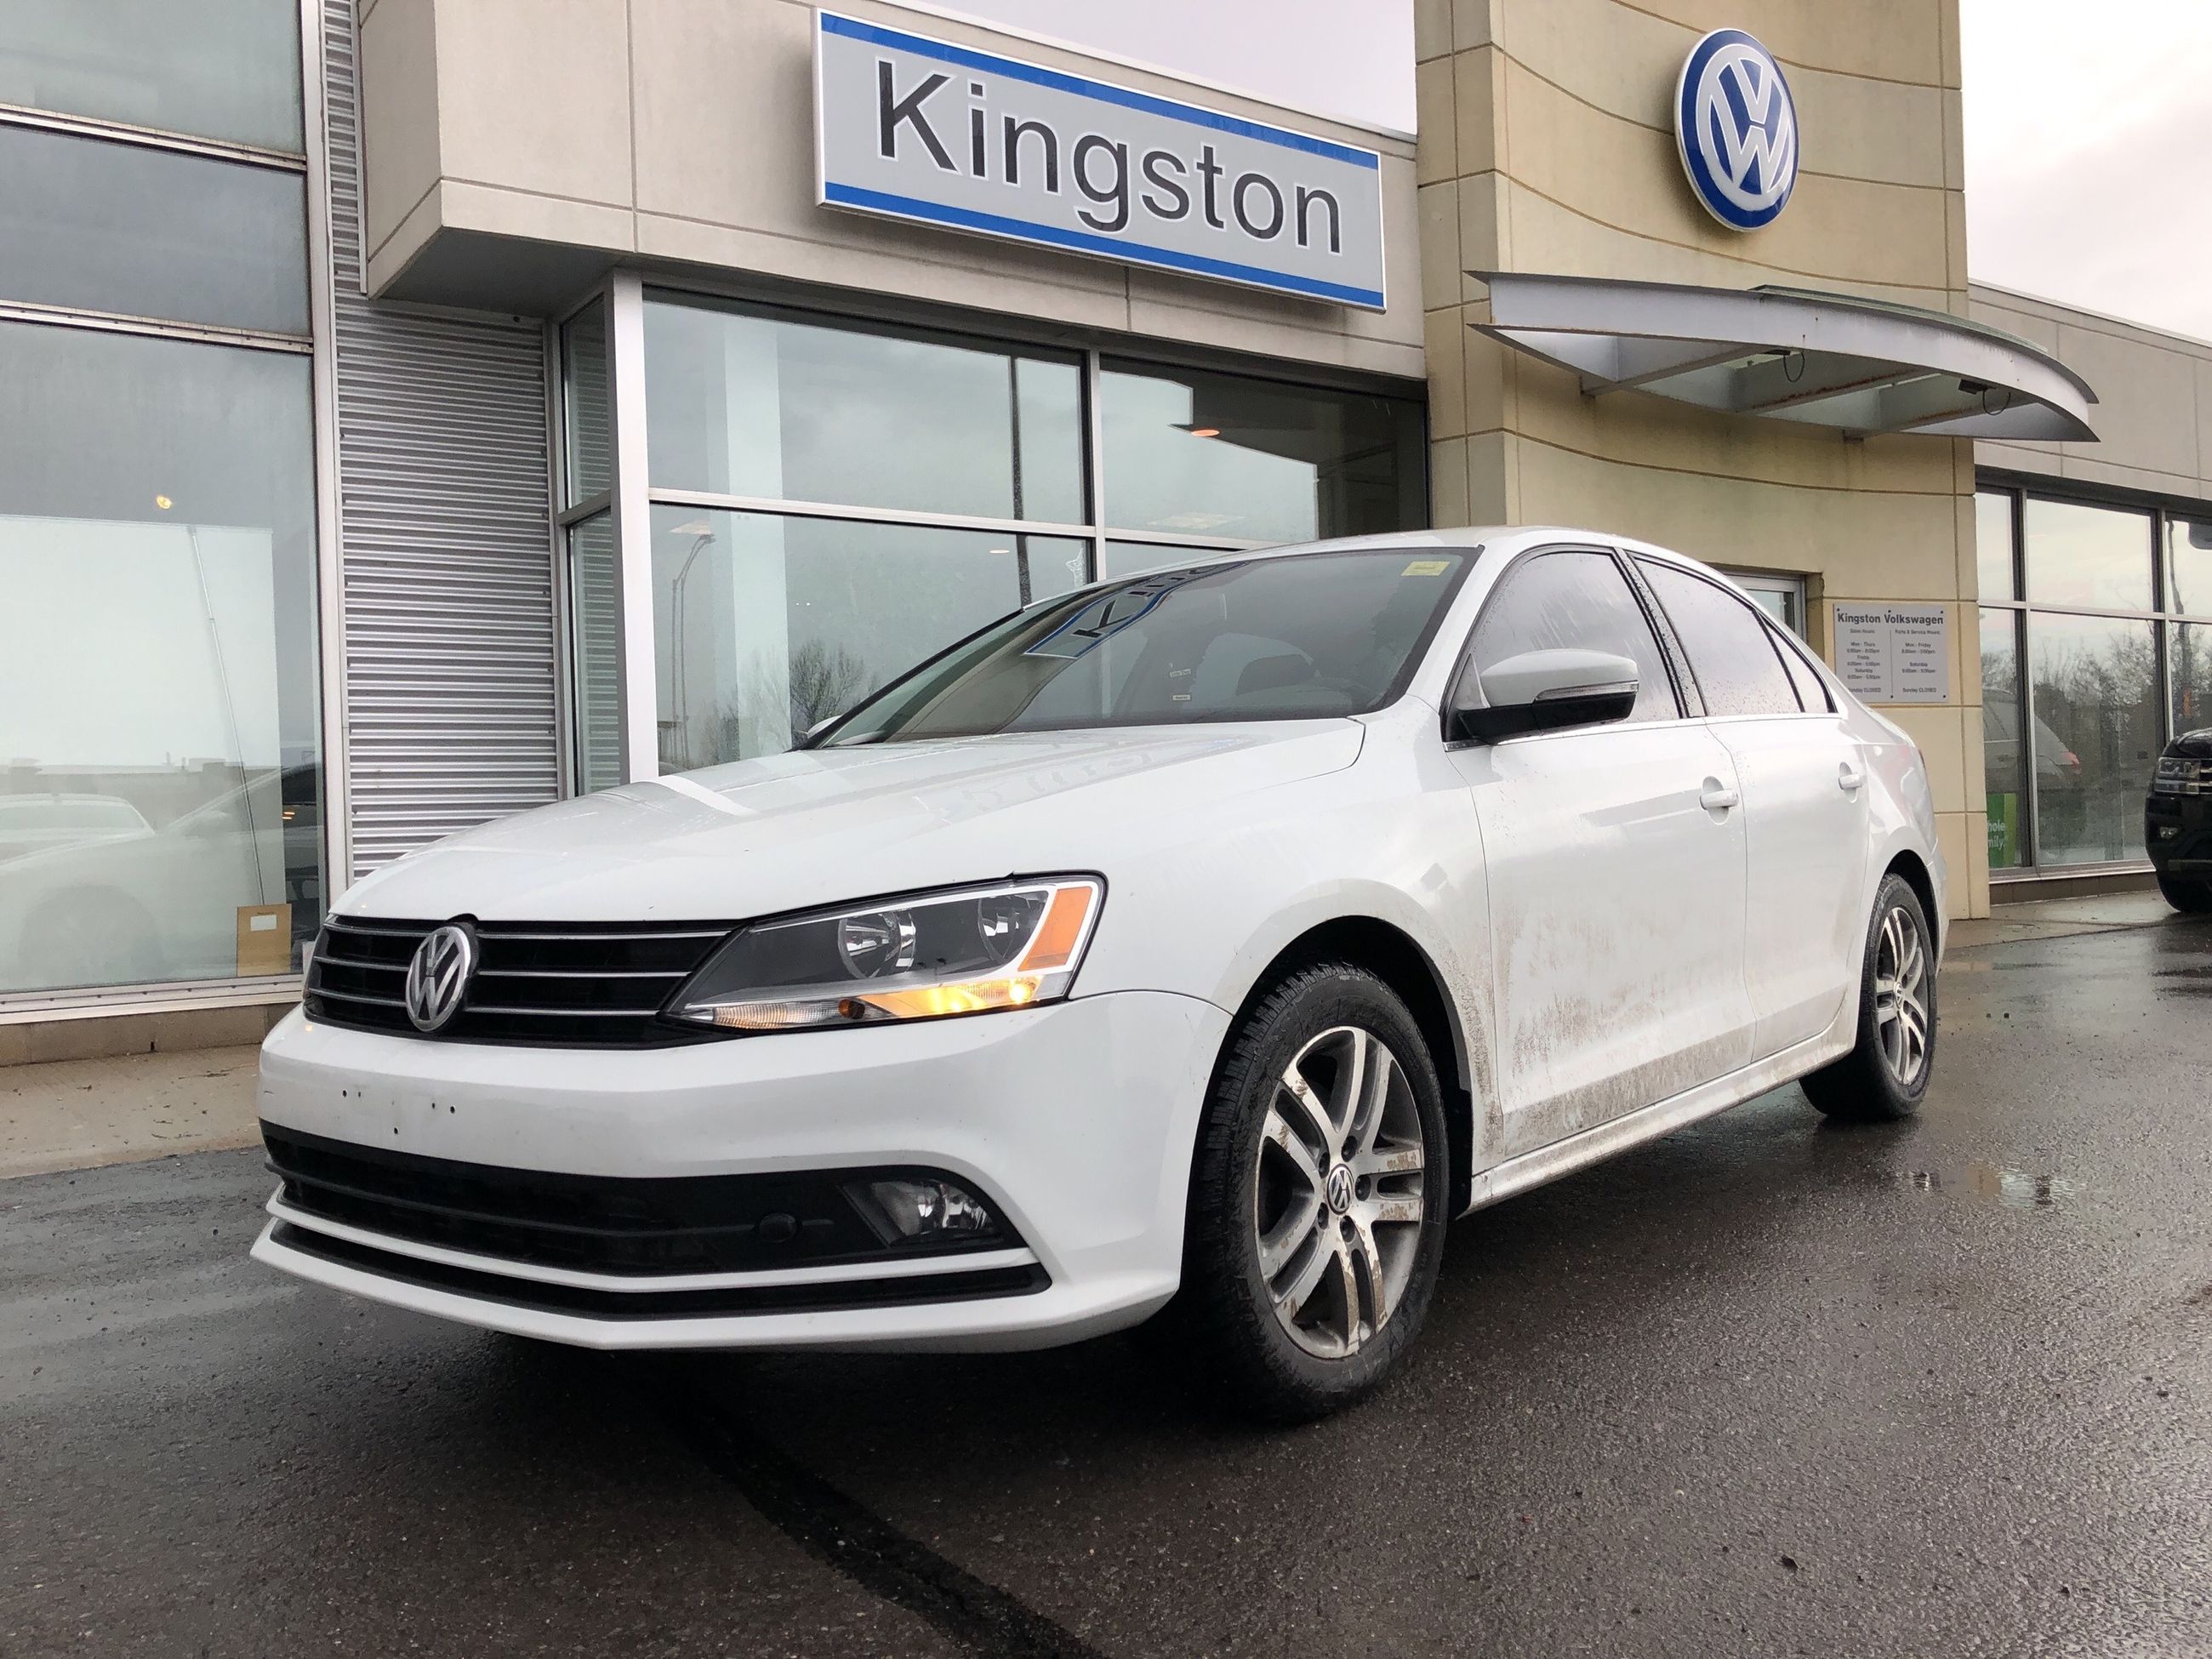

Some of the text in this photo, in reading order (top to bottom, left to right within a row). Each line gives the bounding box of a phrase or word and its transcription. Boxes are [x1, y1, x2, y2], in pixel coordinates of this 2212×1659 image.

[878, 60, 1340, 254] Kingston
[1838, 613, 1943, 625] Kingston Volkswagen
